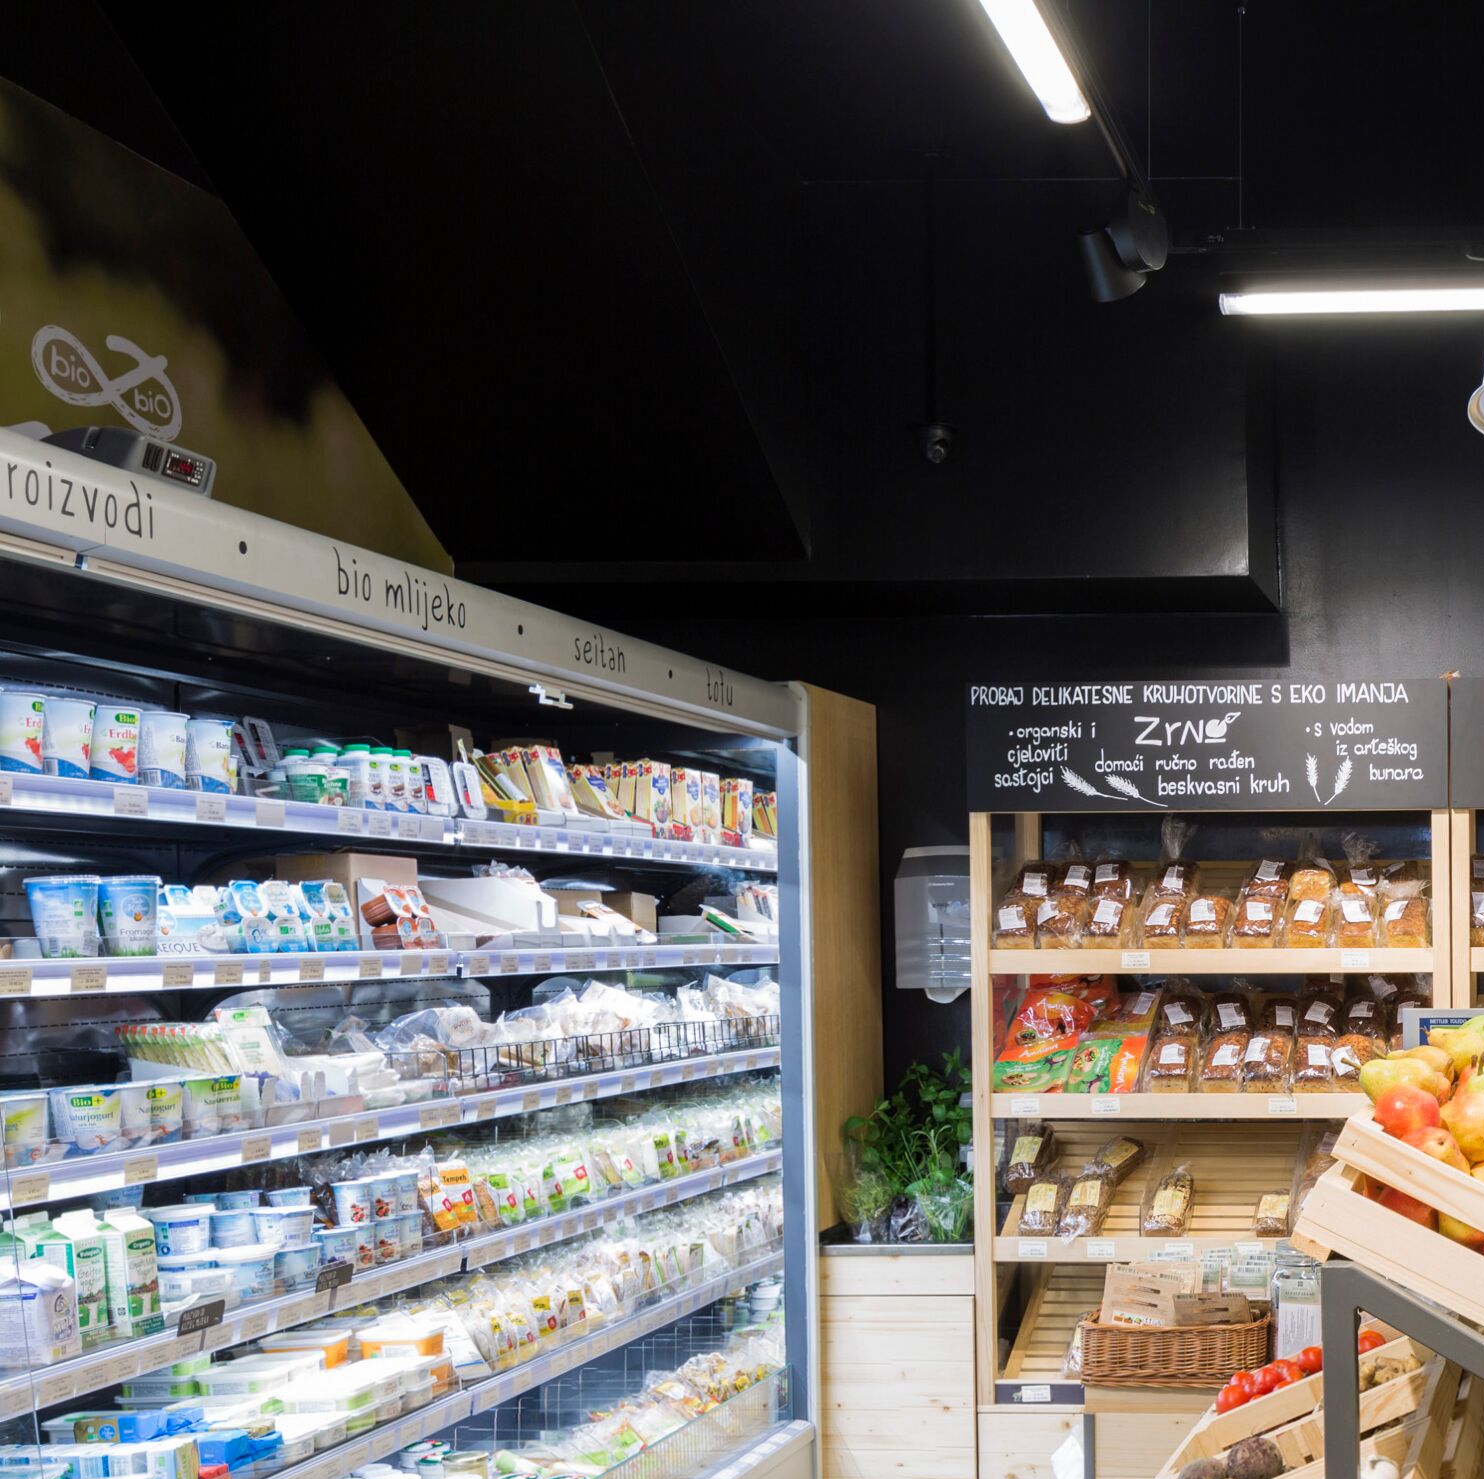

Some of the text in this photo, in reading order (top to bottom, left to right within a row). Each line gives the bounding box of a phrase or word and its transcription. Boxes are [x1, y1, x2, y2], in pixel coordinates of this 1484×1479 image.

[51, 345, 90, 388] bio
[333, 547, 371, 603] bio
[384, 570, 467, 632] mlijeko
[573, 633, 626, 675] seitan
[705, 667, 734, 707] tofu
[971, 683, 1409, 706] PROBAJ DELIKATESNE KRUHOTVORINE S EKO IMANJA
[1017, 719, 1082, 740] organski
[1330, 718, 1373, 737] vodom
[1008, 742, 1068, 765] cjeloviti
[1335, 735, 1417, 760] iz arteškog
[1095, 749, 1254, 773] domaći ručno rađen
[1369, 763, 1424, 782] bunara
[994, 766, 1054, 790] sastojci
[1158, 773, 1290, 797] beskvasni kruh
